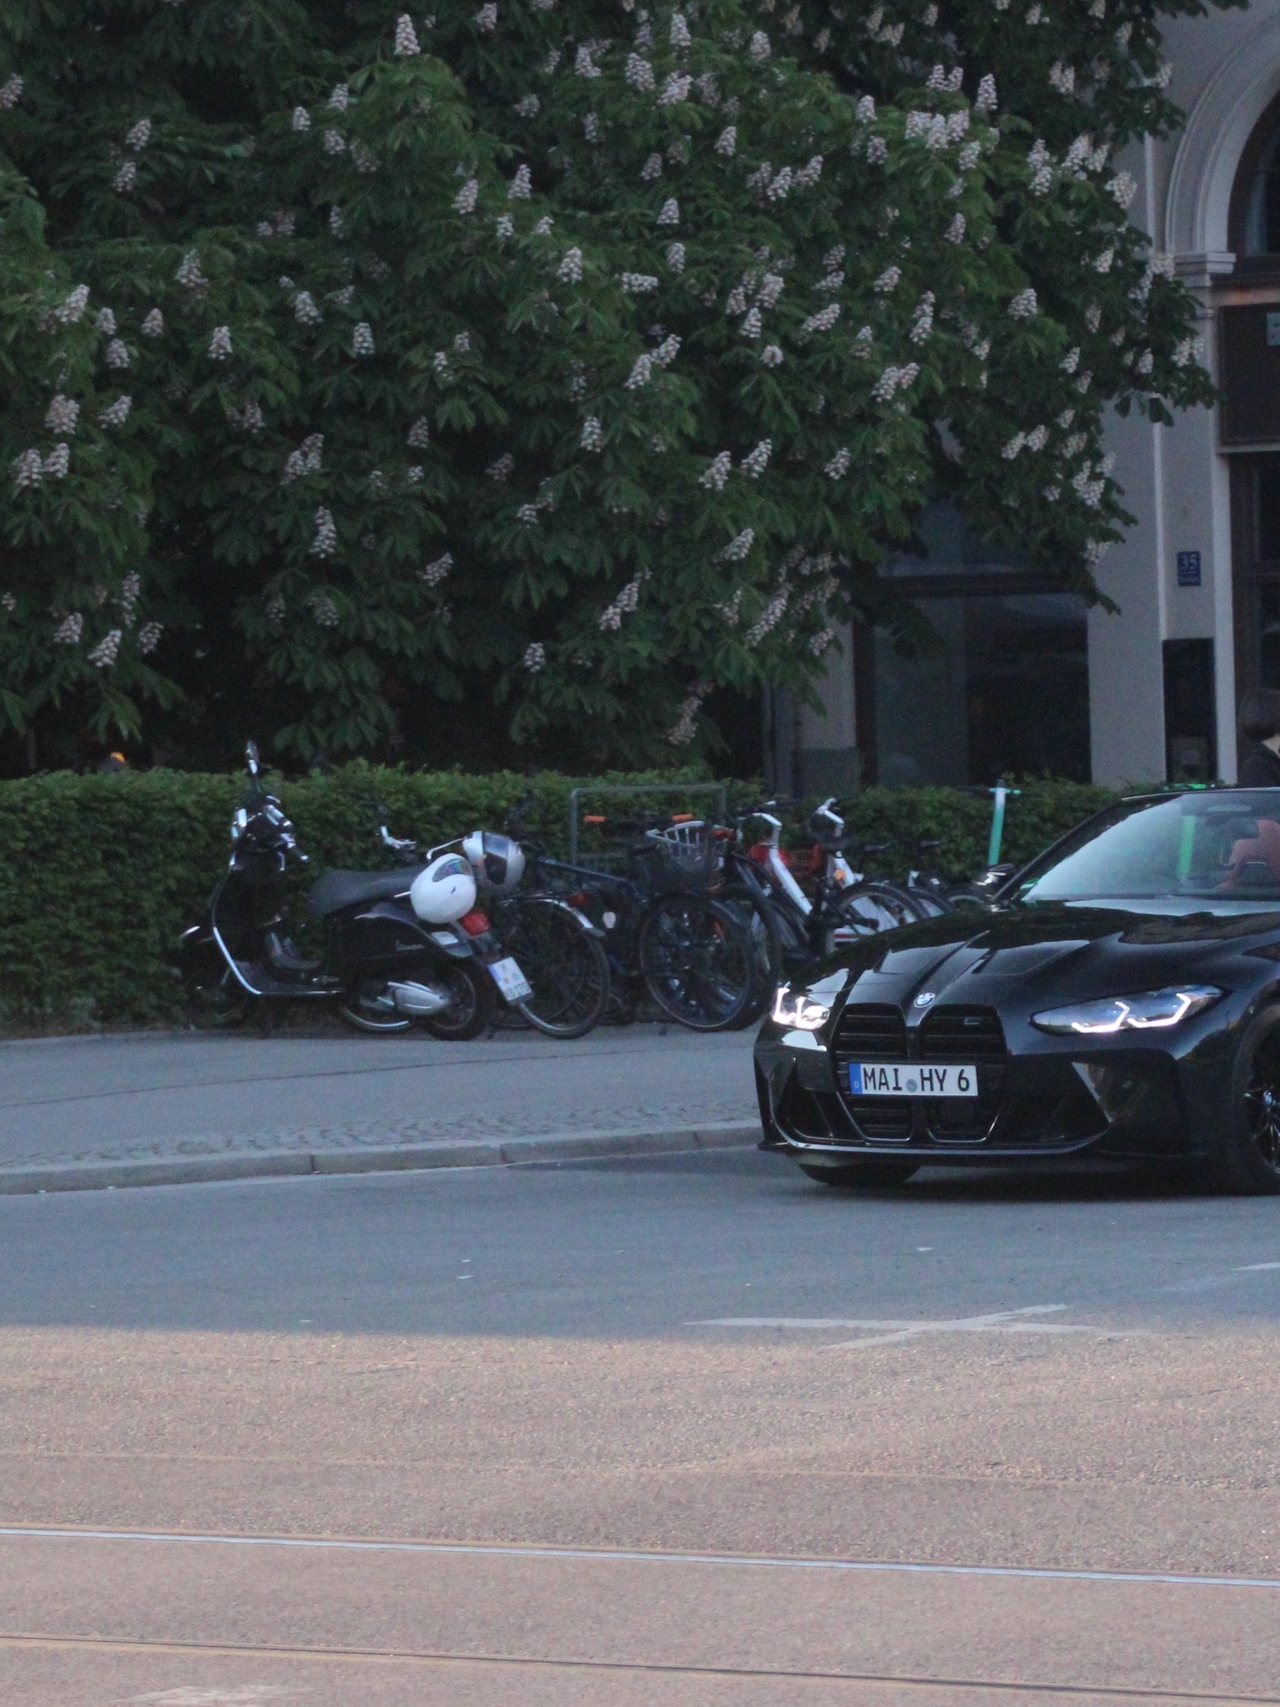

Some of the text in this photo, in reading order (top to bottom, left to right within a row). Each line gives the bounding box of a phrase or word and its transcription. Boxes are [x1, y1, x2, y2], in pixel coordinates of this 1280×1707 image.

[1179, 553, 1198, 570] 35
[863, 1067, 971, 1091] MAI HY 6
